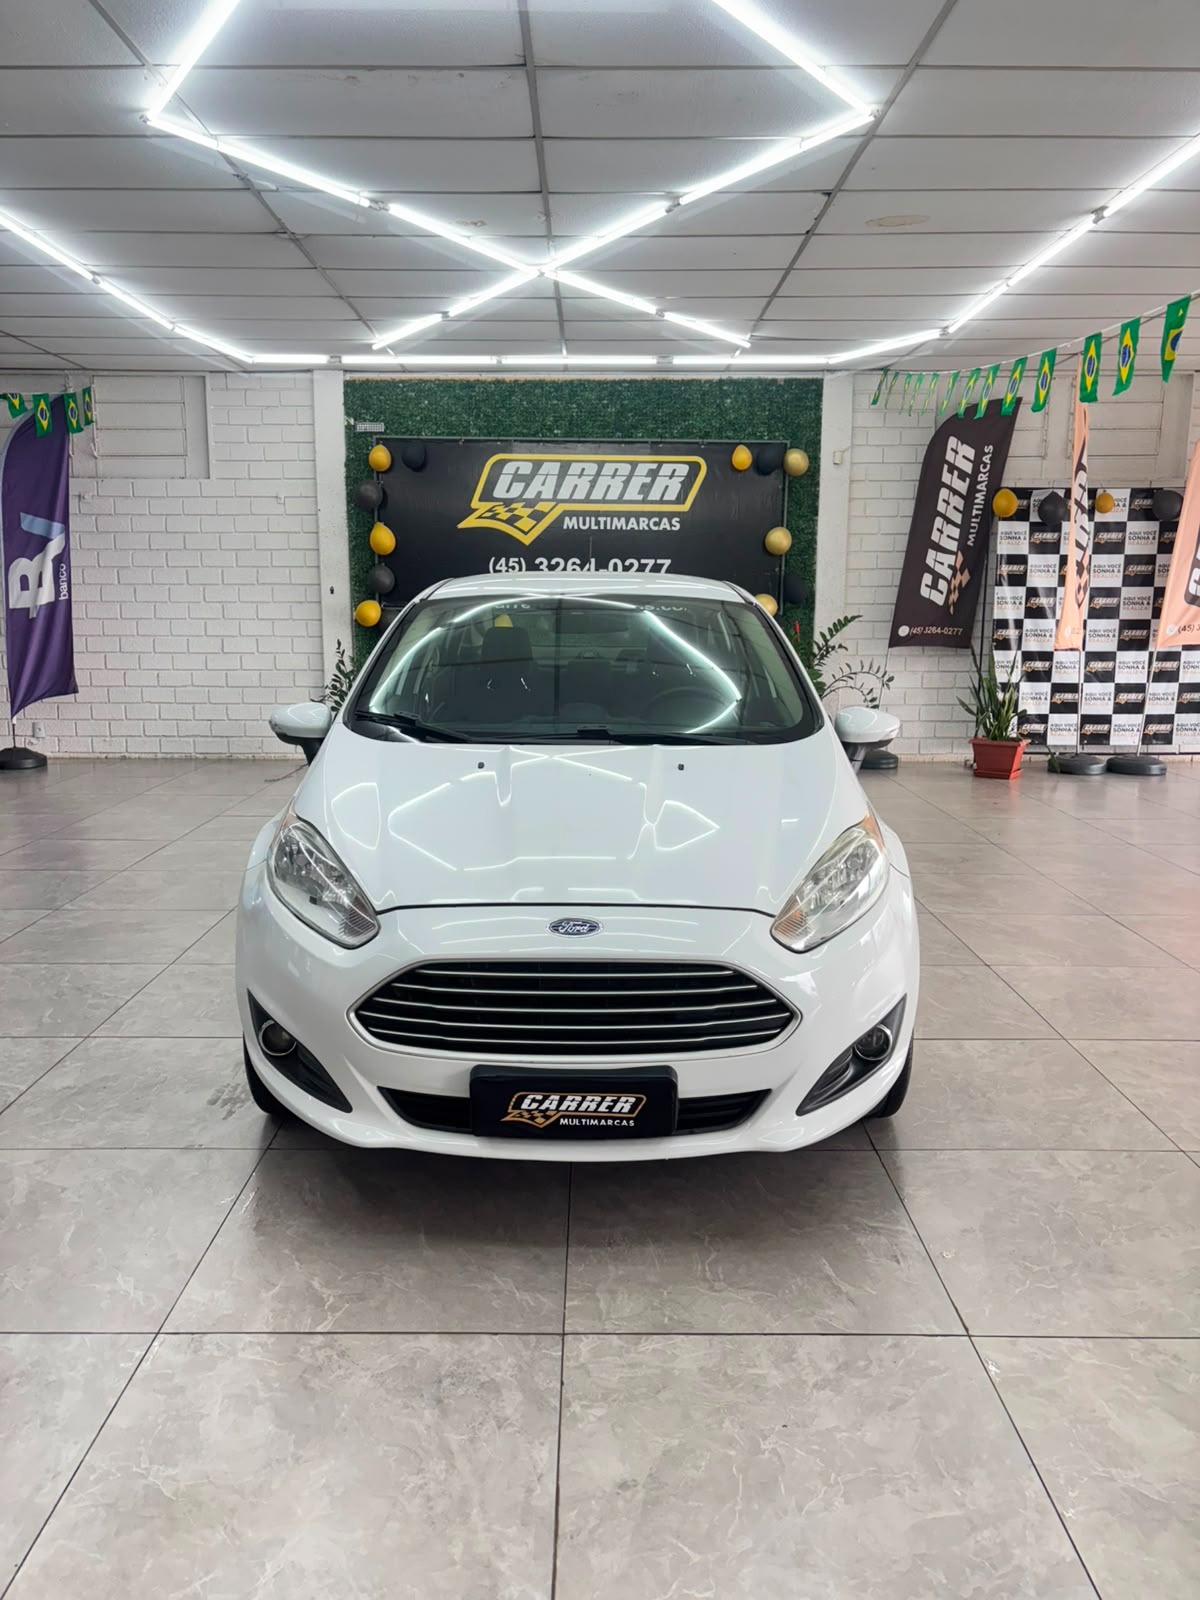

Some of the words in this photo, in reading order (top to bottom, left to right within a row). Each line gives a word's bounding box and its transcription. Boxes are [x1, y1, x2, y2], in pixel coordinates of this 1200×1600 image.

[493, 461, 690, 501] CARRER
[966, 444, 994, 547] MULTIMARCAS
[563, 516, 681, 531] MULTIMARCAS
[919, 435, 976, 607] CARRER
[488, 557, 526, 575] (45)
[58, 563, 69, 601] banco
[923, 626, 963, 636] 3264-0277
[1177, 624, 1195, 634] (45)
[559, 920, 591, 933] Ford
[520, 1094, 637, 1113] CARRER
[559, 1118, 635, 1126] MULTIMARCAS
